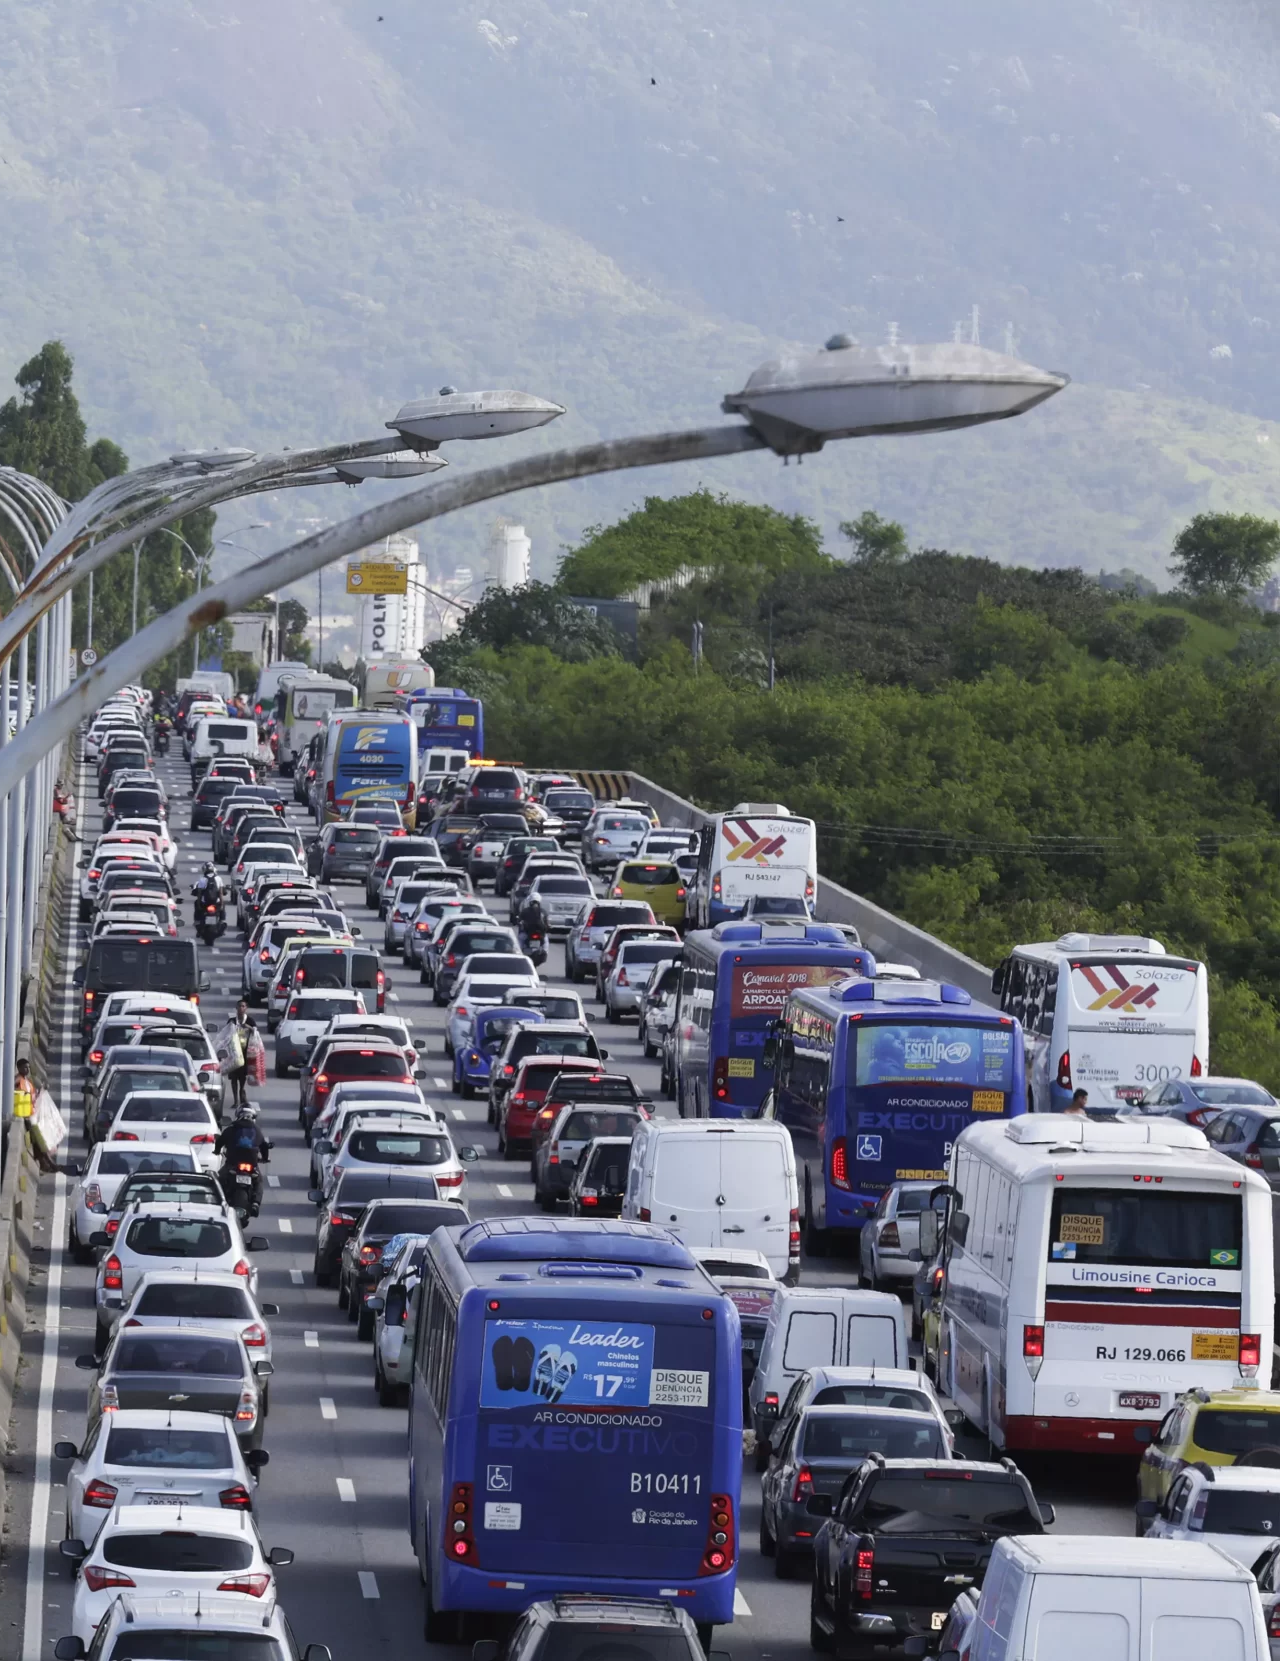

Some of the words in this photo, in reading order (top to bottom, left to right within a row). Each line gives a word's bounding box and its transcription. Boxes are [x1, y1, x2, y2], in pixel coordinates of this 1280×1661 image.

[84, 652, 94, 660] 90
[360, 755, 384, 763] 4030
[766, 824, 808, 834] Solazer
[742, 971, 784, 986] Carnaval
[787, 973, 807, 983] 2018
[1133, 968, 1187, 982] Solazer
[887, 1098, 900, 1106] AR
[901, 1098, 969, 1109] CONDICIONADO
[1063, 1216, 1102, 1226] DISQUE
[1062, 1224, 1101, 1234] DENÚNCIA
[1061, 1233, 1101, 1242] 2253-1177
[1072, 1268, 1152, 1284] Limousine
[1156, 1272, 1217, 1287] Carioca
[569, 1325, 645, 1349] Leader
[607, 1352, 640, 1361] Chinelos
[1096, 1346, 1117, 1360] RJ
[1124, 1347, 1186, 1362] 129.066
[597, 1360, 639, 1369] masculinos
[655, 1372, 703, 1385] DISQUE
[583, 1373, 593, 1381] R$
[593, 1374, 623, 1398] 17
[655, 1383, 703, 1394] DENÚNCIA
[655, 1393, 703, 1404] 2253-1177
[533, 1412, 553, 1424] AR
[555, 1412, 663, 1427] CONDICIONADO
[487, 1423, 699, 1457] EXECUTIVO
[629, 1472, 702, 1495] B10411
[648, 1510, 674, 1518] Cidade
[675, 1510, 686, 1518] do
[648, 1517, 661, 1525] Rio
[671, 1518, 698, 1526] Janeiro
